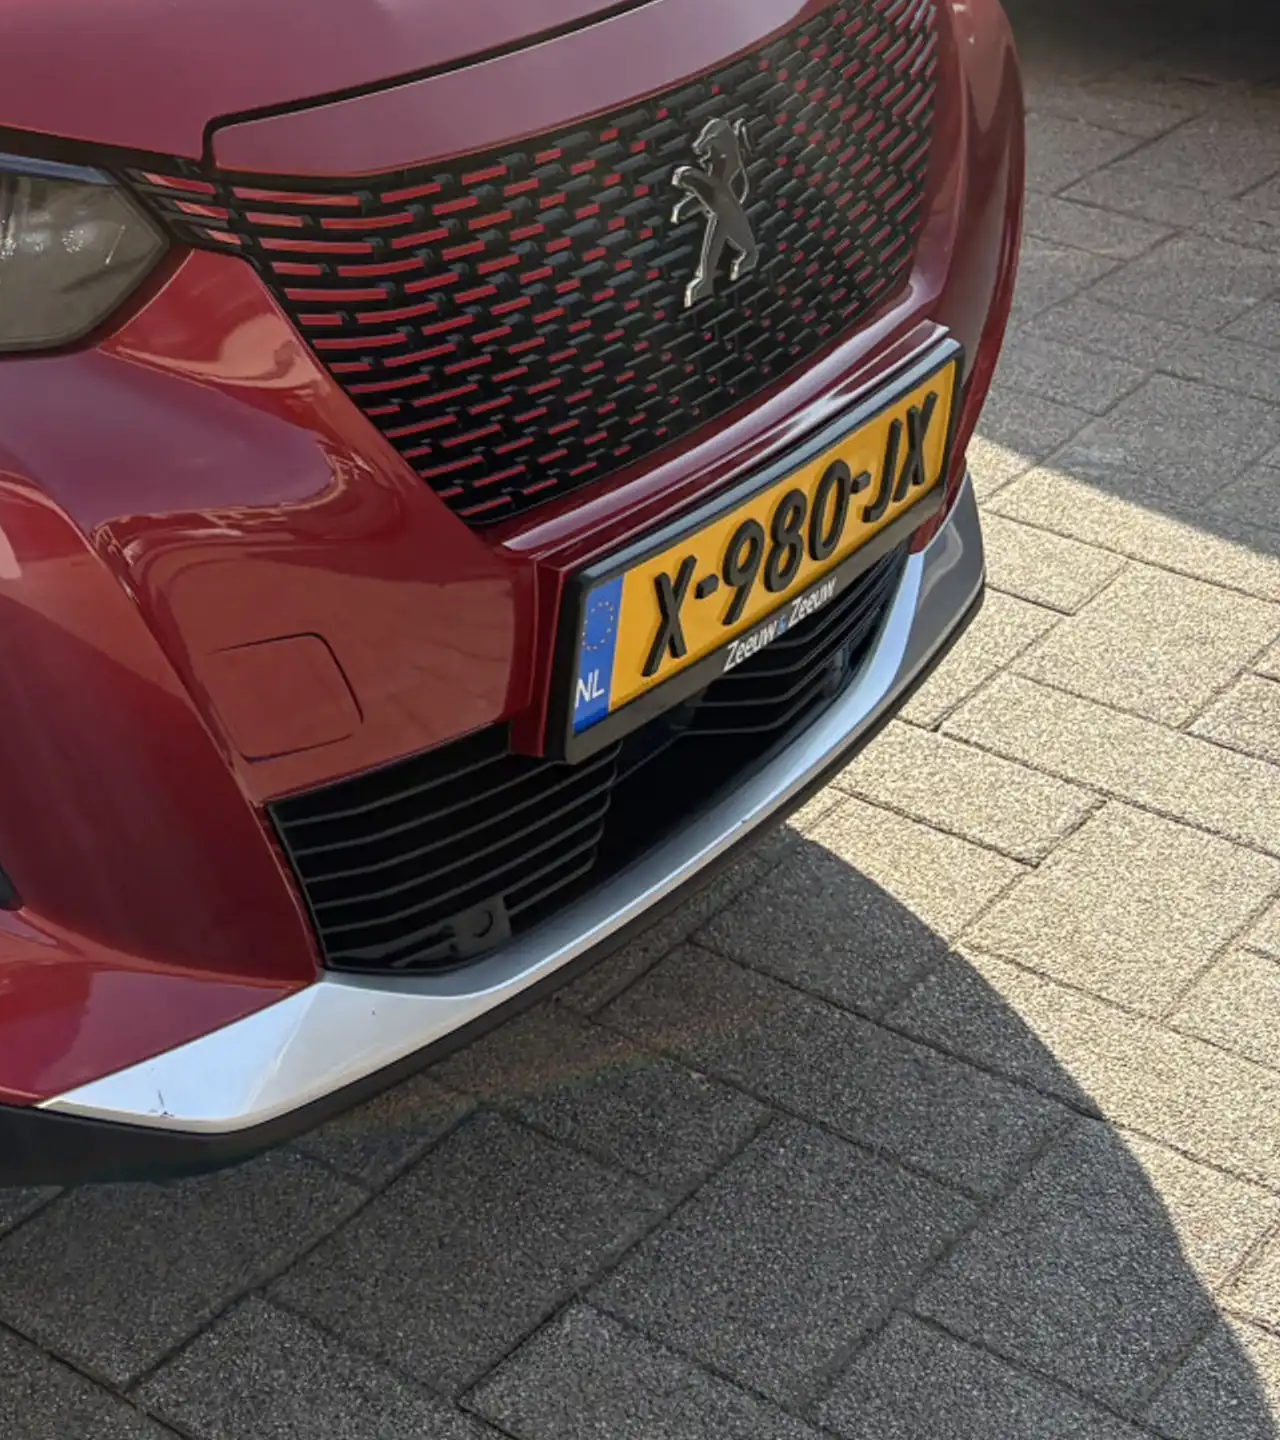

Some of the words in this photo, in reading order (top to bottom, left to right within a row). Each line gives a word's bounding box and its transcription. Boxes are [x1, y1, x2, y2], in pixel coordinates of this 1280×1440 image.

[641, 391, 938, 678] X-980-JX
[723, 620, 778, 674] Zeeuw
[787, 576, 838, 629] Zeeuw
[574, 668, 605, 710] NL
